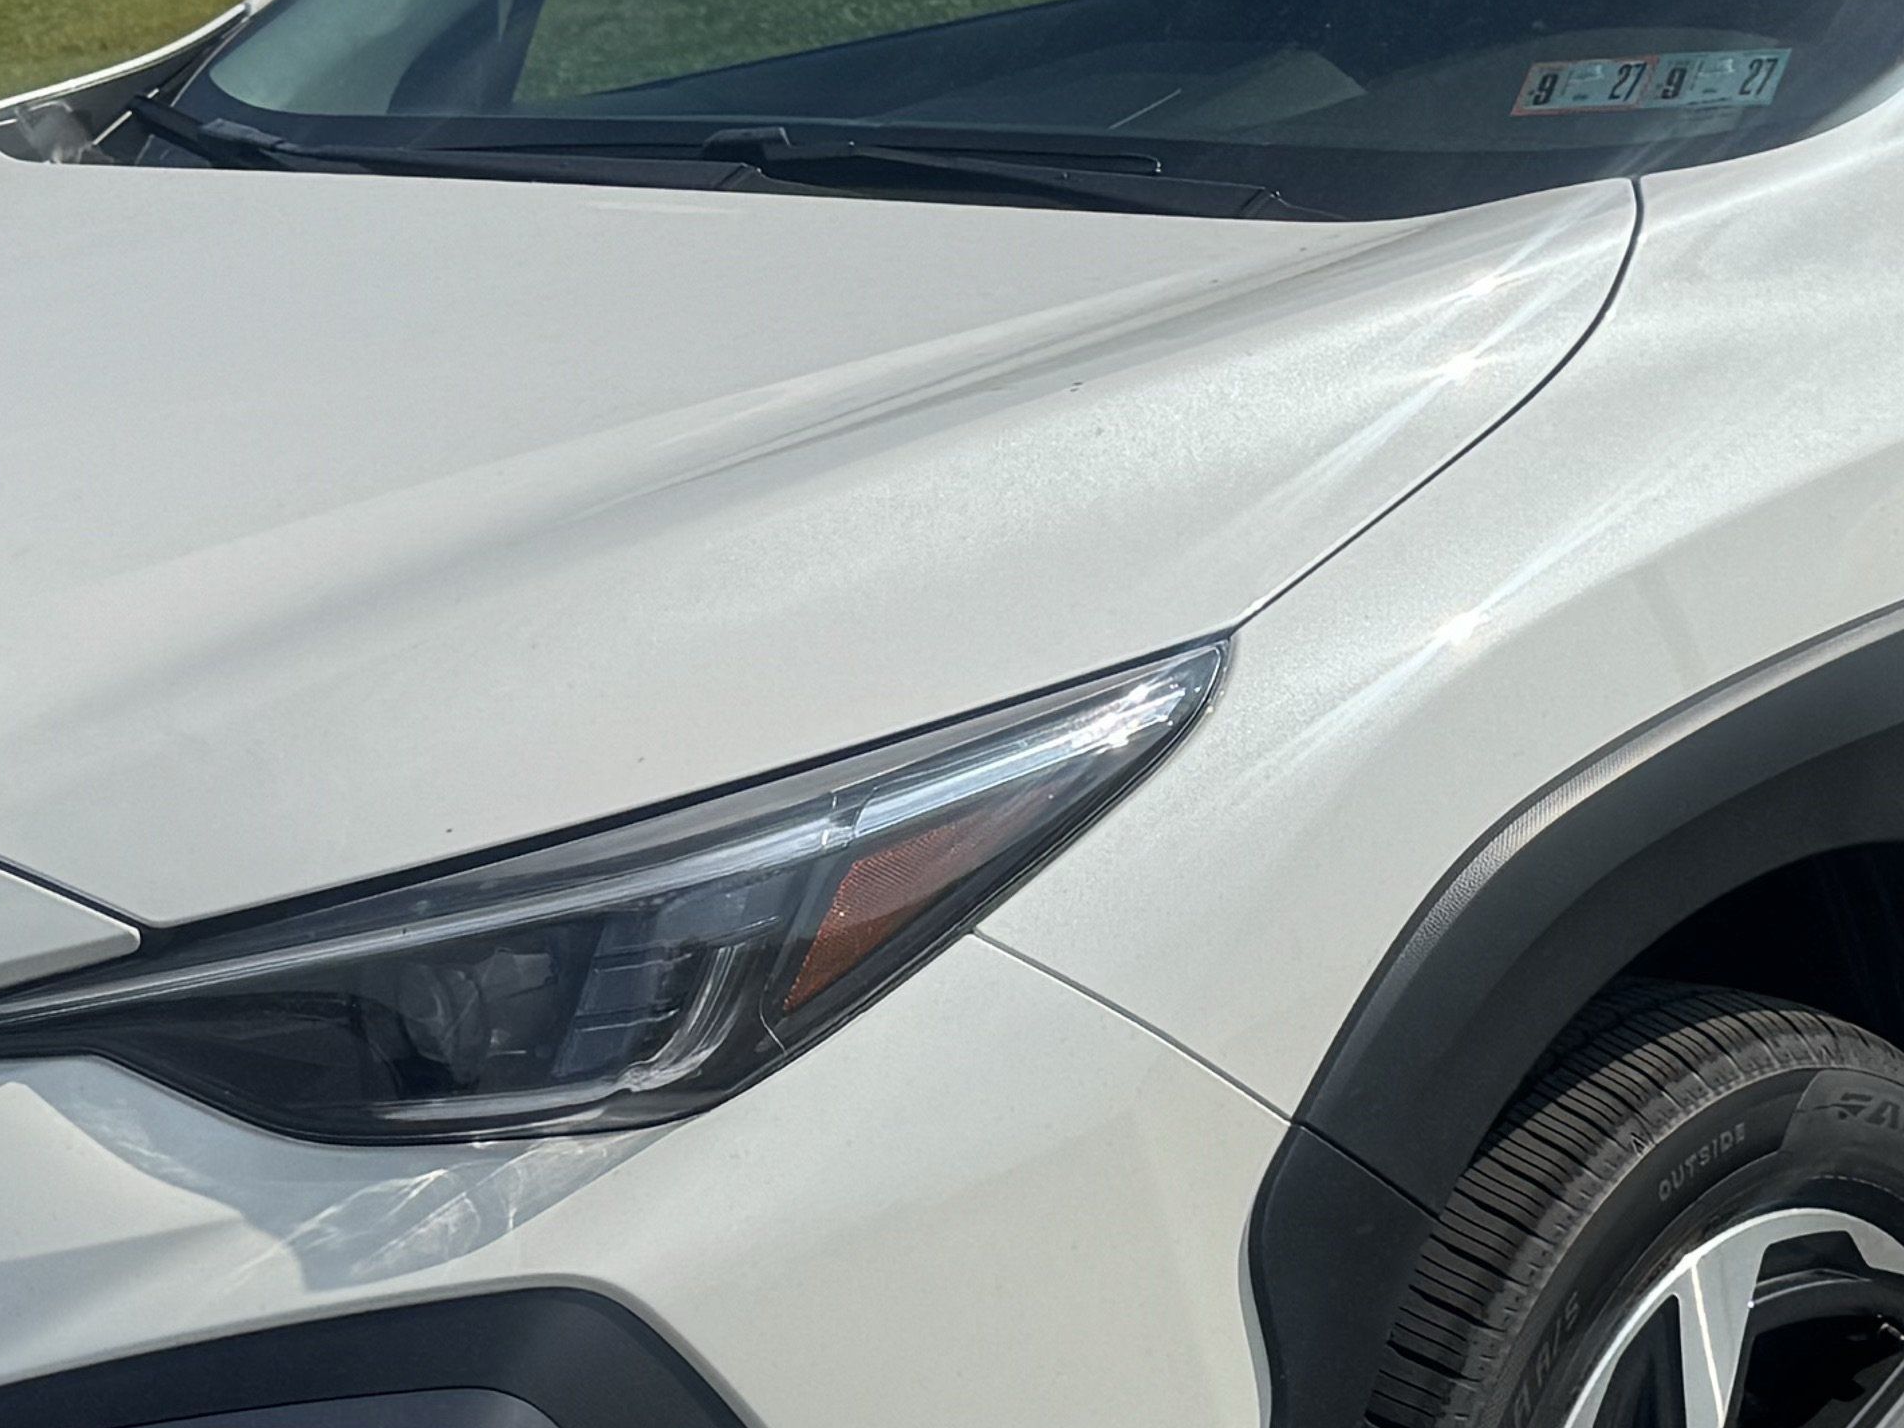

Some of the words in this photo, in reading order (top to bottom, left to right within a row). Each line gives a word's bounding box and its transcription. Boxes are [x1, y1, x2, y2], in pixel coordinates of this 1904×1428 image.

[1532, 73, 1559, 106] 9
[1608, 62, 1647, 102] 27
[1661, 67, 1688, 100] 9
[1739, 57, 1779, 96] 27
[1658, 1123, 1745, 1202] OUTSIDE
